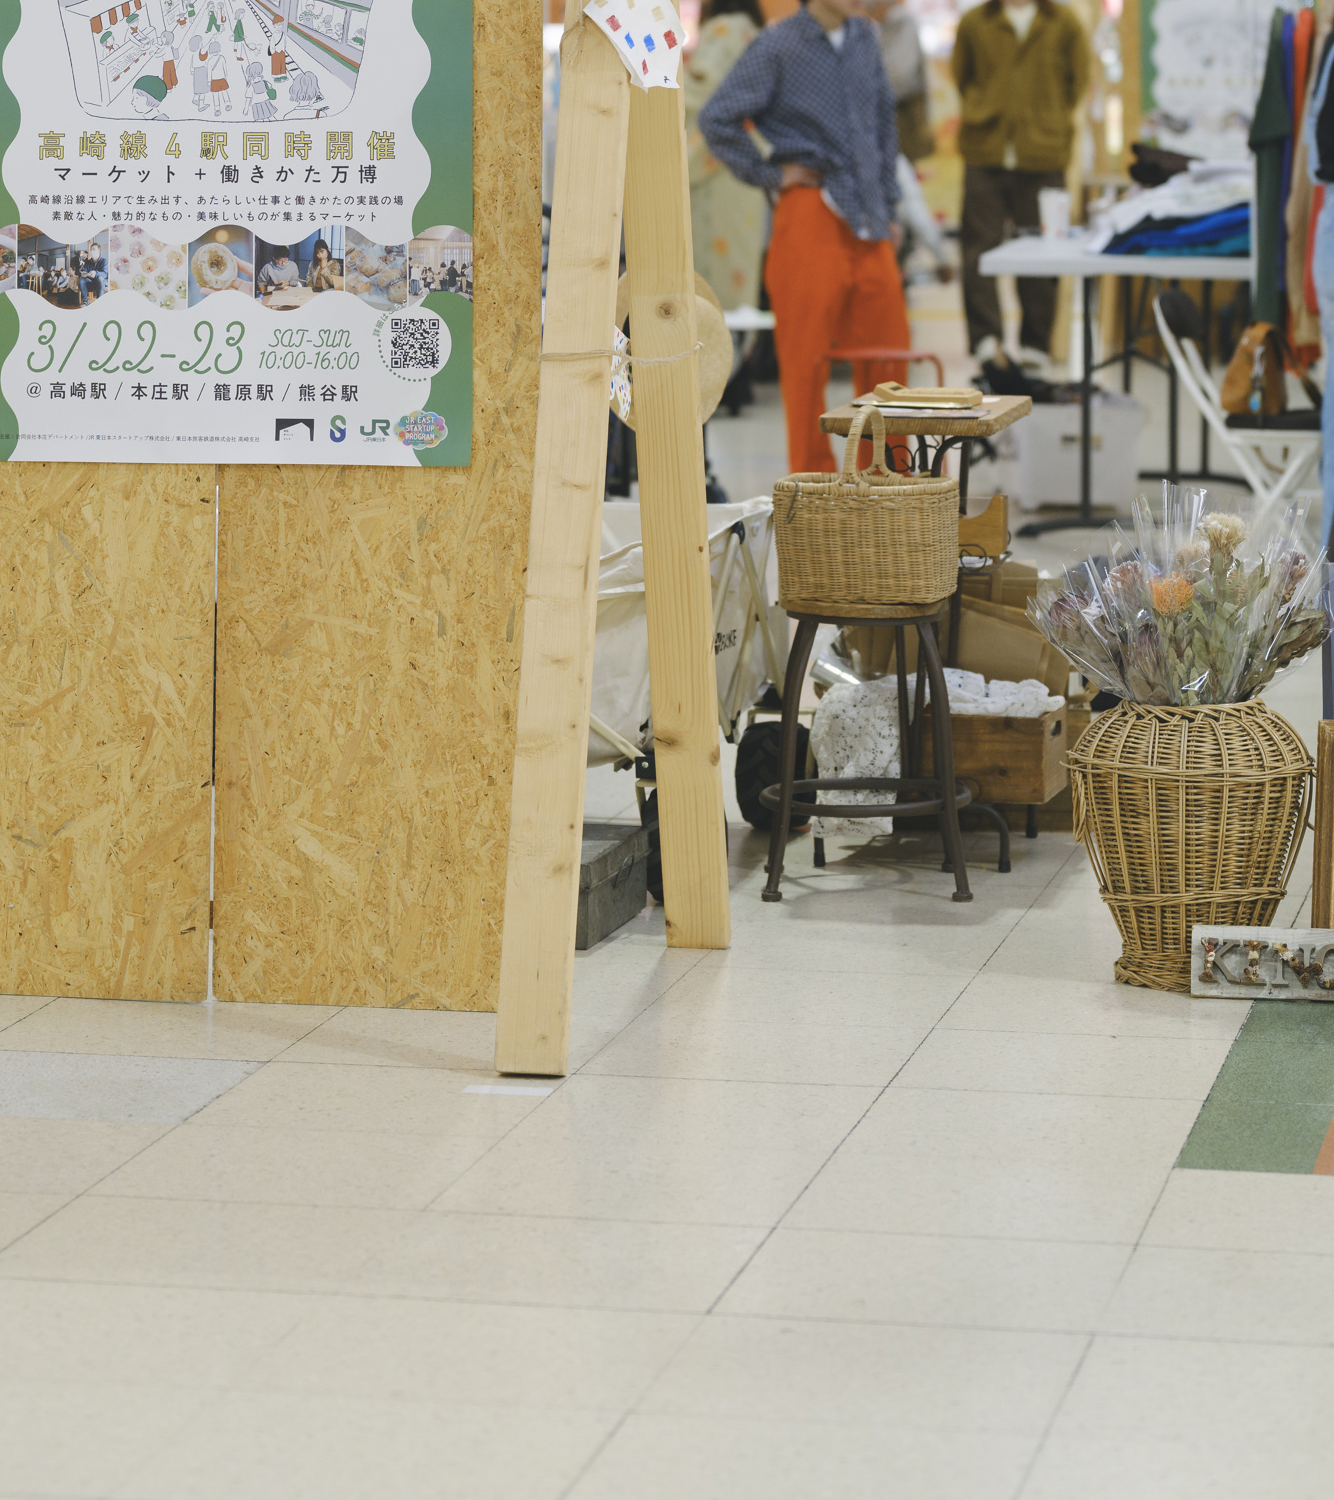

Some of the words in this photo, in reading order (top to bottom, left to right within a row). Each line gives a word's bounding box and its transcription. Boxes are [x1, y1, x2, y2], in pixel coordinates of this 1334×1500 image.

[38, 131, 396, 161] 高崎線4駅同時開催
[26, 319, 245, 375] 3/22-23
[258, 351, 360, 370] 10:00-16:00
[49, 382, 107, 400] 高崎駅
[131, 383, 189, 401] 本庄駅
[214, 384, 274, 402] 籠原駅
[298, 384, 359, 402] 熊谷駅
[360, 419, 390, 436] JR
